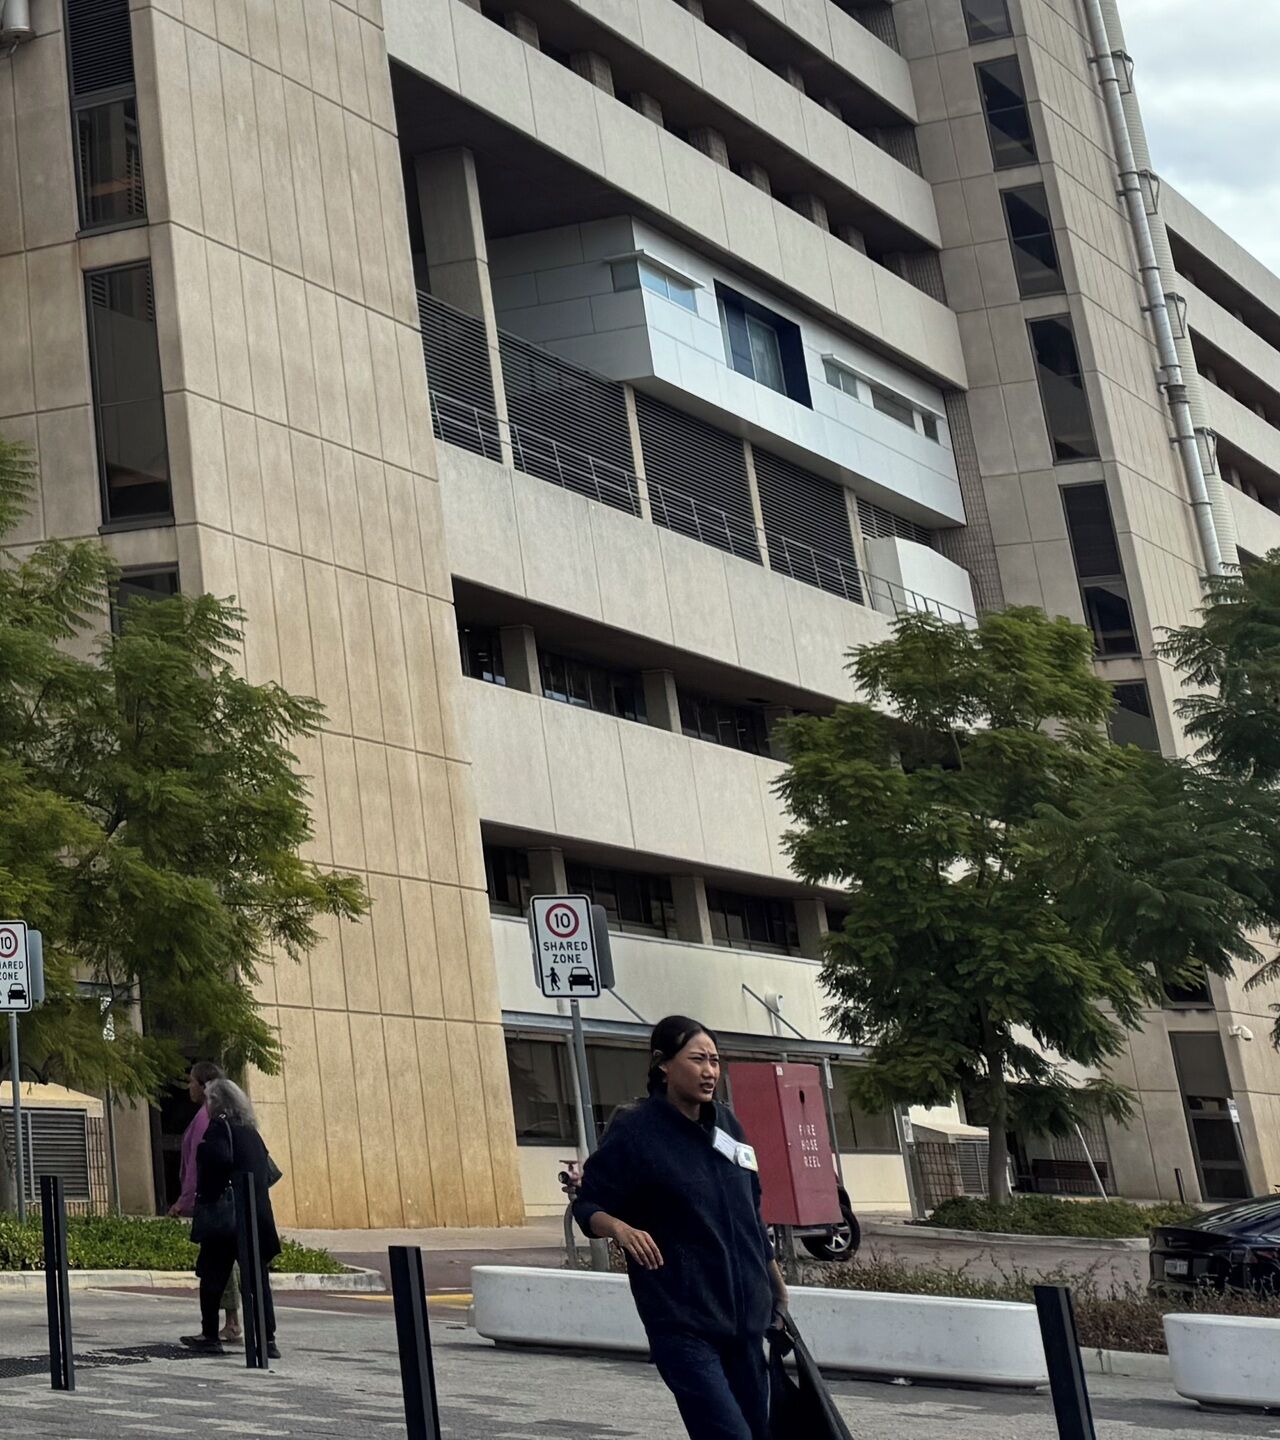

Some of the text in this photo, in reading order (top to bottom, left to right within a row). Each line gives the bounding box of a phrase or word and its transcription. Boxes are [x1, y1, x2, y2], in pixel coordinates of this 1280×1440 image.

[554, 913, 570, 928] 10
[0, 936, 12, 950] 10
[543, 941, 588, 951] SHARED
[552, 954, 582, 963] ZONE
[799, 1124, 816, 1136] FIRE
[801, 1139, 818, 1151] HOSE
[804, 1156, 821, 1167] REEL
